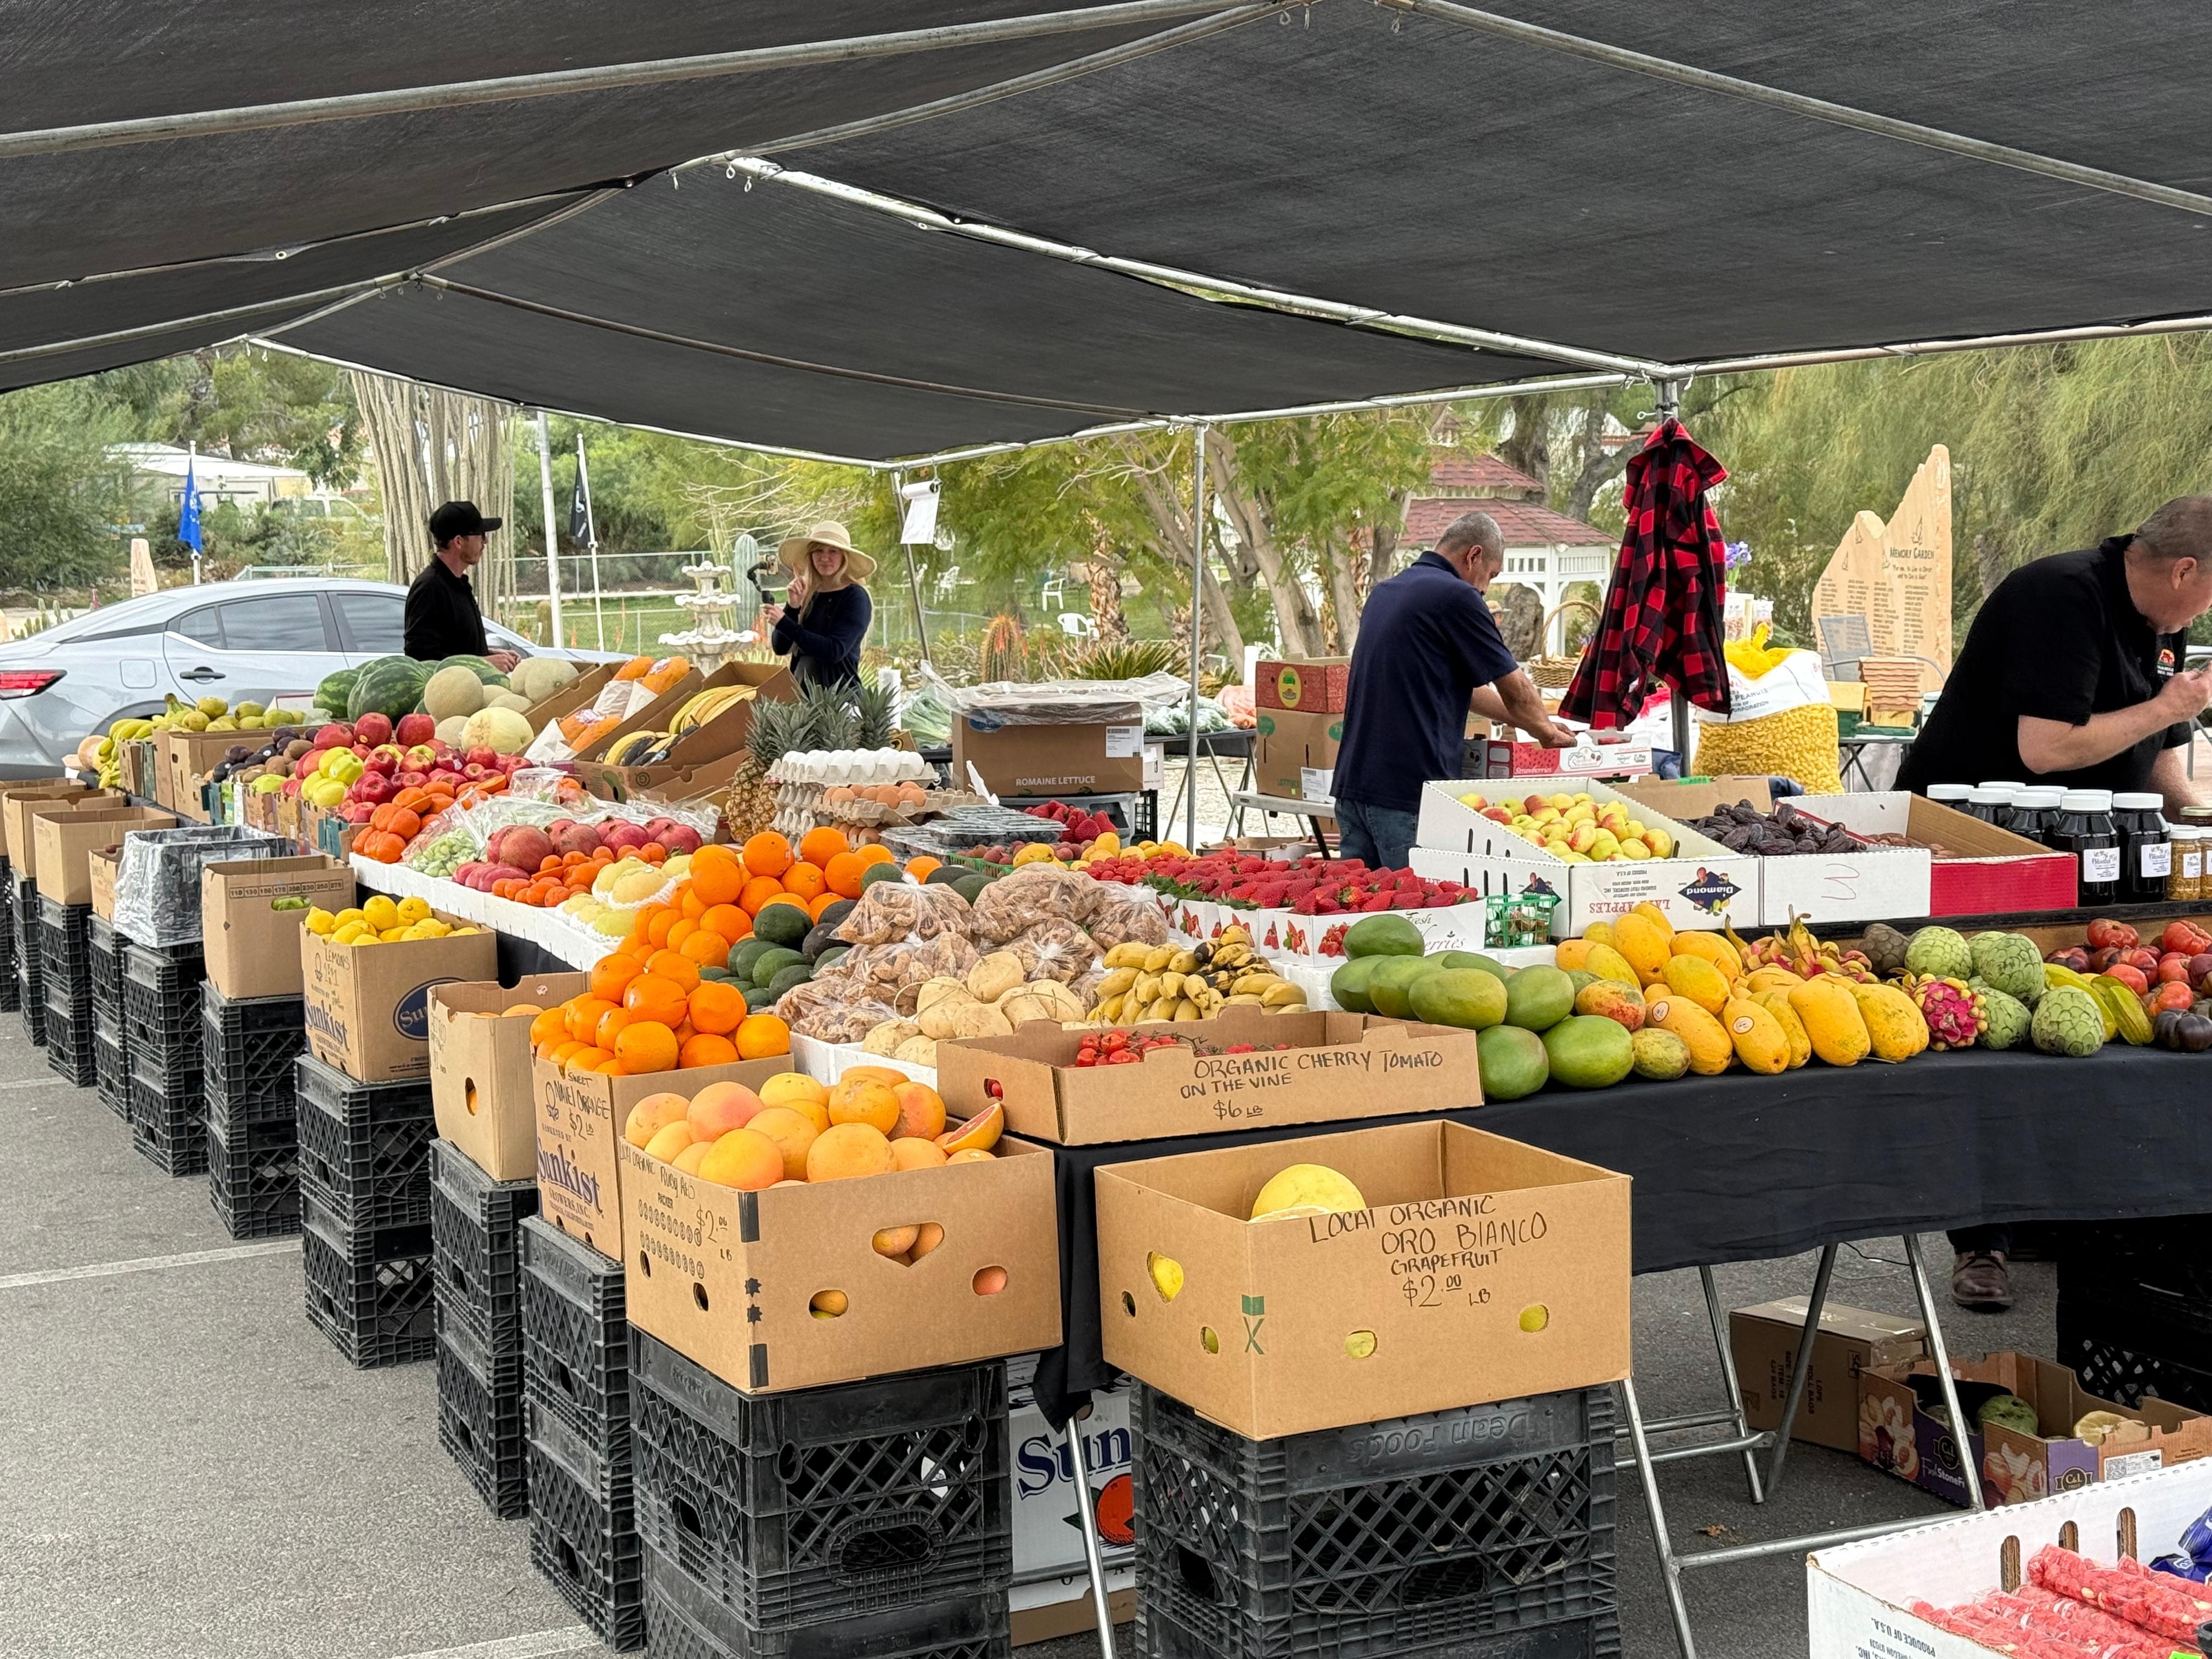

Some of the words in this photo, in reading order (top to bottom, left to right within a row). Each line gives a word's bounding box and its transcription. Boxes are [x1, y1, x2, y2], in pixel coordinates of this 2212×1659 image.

[1890, 546, 1912, 558] MEMORY
[1914, 547, 1934, 559] GARDEN
[1733, 701, 1769, 713] ORPORATION
[1016, 777, 1057, 787] ROMAINE
[1058, 775, 1096, 785] LETTUCE
[1686, 885, 1734, 897] Diamond
[1589, 901, 1635, 914] APPLES
[305, 995, 350, 1052] Sunkist
[1194, 1055, 1289, 1079] ORGANIC
[1297, 1051, 1371, 1071] CHERRY
[1379, 1050, 1443, 1073] TOMATO
[568, 1072, 592, 1088] SWEET
[1181, 1081, 1206, 1099] ON
[1211, 1079, 1245, 1094] THE
[1248, 1073, 1292, 1090] VINE
[577, 1089, 611, 1119] ORANGE
[1213, 1099, 1242, 1120] $6
[1246, 1105, 1263, 1118] LB
[569, 1108, 587, 1141] $2
[538, 1136, 603, 1216] Sunkist
[1390, 1195, 1497, 1225] ORGANIC
[1381, 1227, 1436, 1255] ORO
[720, 1248, 732, 1261] LB
[1391, 1248, 1503, 1276] GRAPEFRUIT
[1402, 1274, 1463, 1307] $2.00
[1469, 1288, 1491, 1306] LB
[1452, 1409, 1529, 1445] Dean
[1347, 1424, 1442, 1467] Foods
[2066, 1474, 2082, 1484] C&L
[1871, 1618, 1892, 1637] U.S.A.
[1894, 1629, 1903, 1641] OF
[1903, 1633, 1936, 1657] PRODUCE
